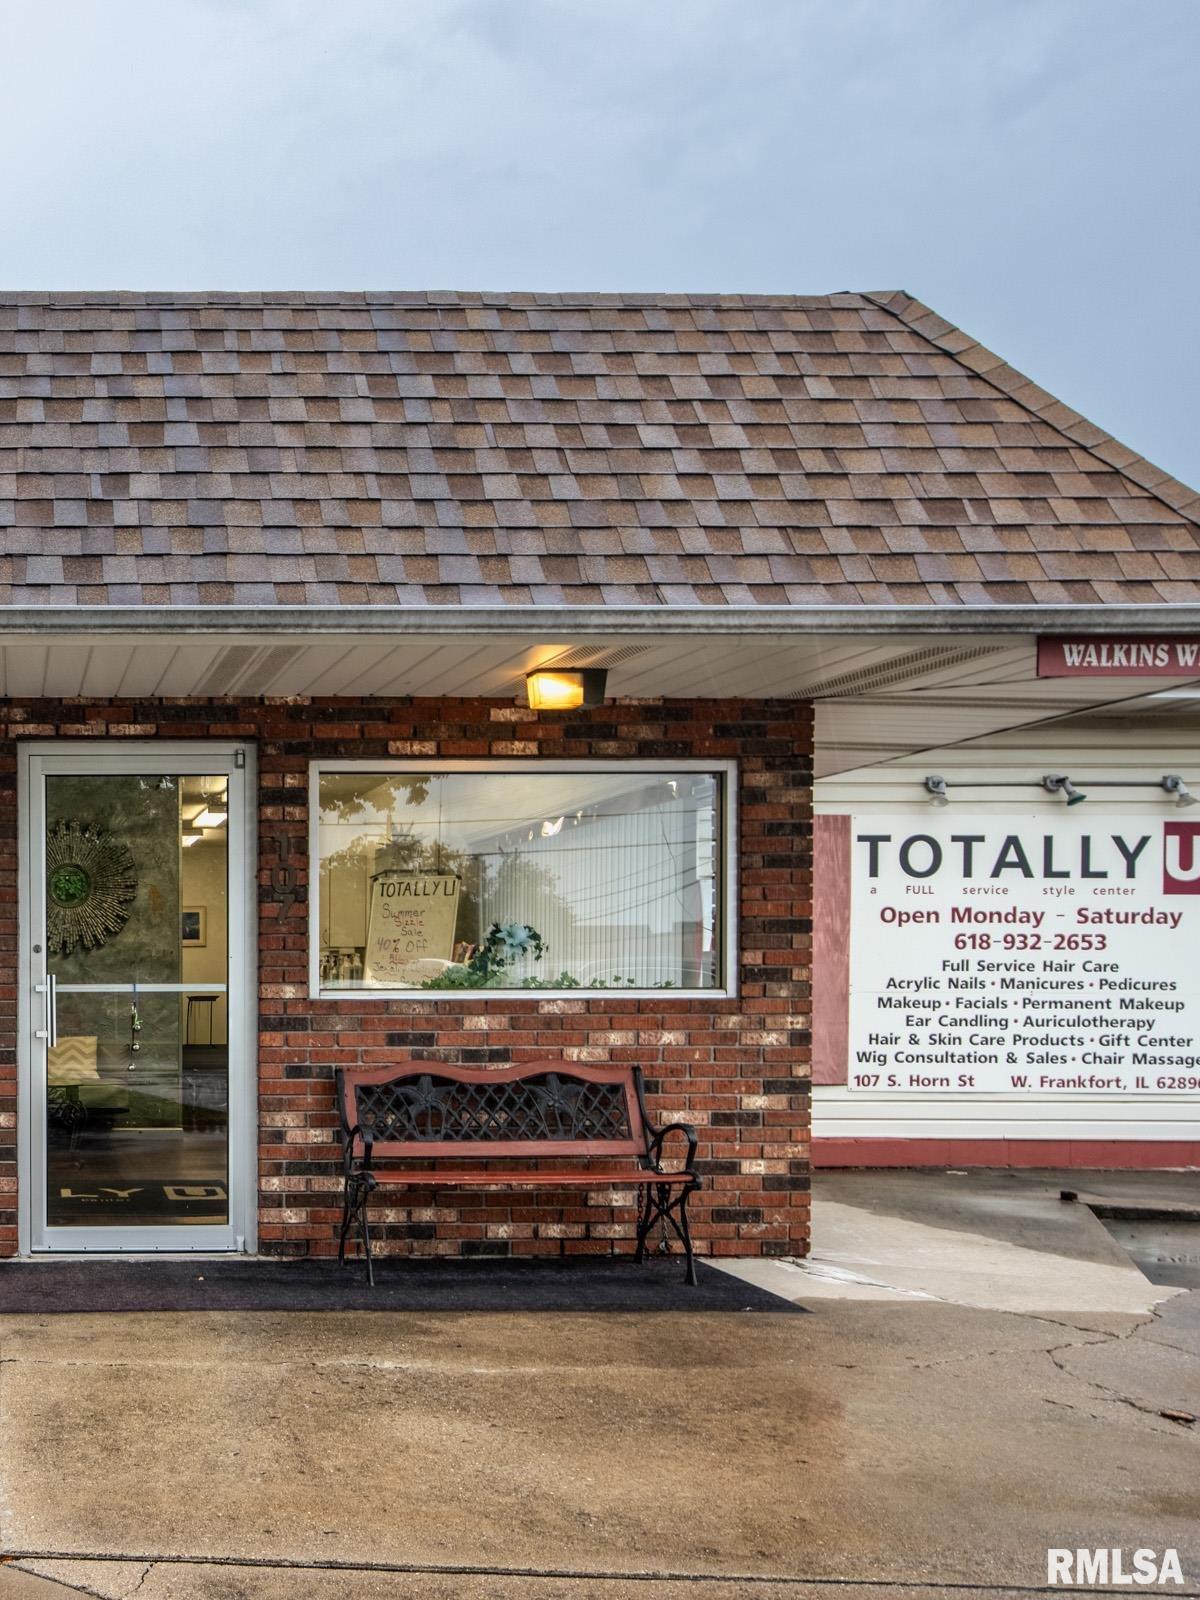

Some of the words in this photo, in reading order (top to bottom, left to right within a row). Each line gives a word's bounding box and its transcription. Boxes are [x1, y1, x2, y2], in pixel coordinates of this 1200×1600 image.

[1062, 644, 1170, 667] WALKINS
[1176, 644, 1200, 667] W
[856, 833, 1153, 880] TOTALLY
[1164, 834, 1200, 881] U
[379, 881, 441, 898] TOTALLY
[443, 879, 457, 896] U
[869, 886, 878, 896] a
[905, 885, 935, 895] FULL
[961, 885, 1010, 896] service
[1042, 885, 1076, 898] style
[1092, 886, 1137, 896] center
[382, 903, 426, 919] Summer
[879, 906, 940, 928] Open
[951, 905, 1046, 929] Monday
[1076, 906, 1184, 930] Saturday
[400, 926, 424, 936] Sale
[954, 932, 1107, 951] 618-932-2653
[942, 959, 970, 972] Full
[976, 959, 1036, 973] Service
[1042, 959, 1076, 973] Hair
[1081, 960, 1120, 973] Care
[885, 976, 941, 992] Acrylic
[947, 977, 986, 990] Nails
[1000, 977, 1085, 991] Manicures
[1099, 977, 1177, 991] Pedicures
[877, 996, 942, 1011] Makeup
[955, 996, 1008, 1010] Facials
[1022, 997, 1112, 1010] Permanent
[1119, 998, 1185, 1013] Makeup
[905, 1014, 932, 1027] Ear
[938, 1014, 1009, 1031] Candling
[1022, 1015, 1156, 1032] Auriculotherapy
[868, 1033, 901, 1046] Hair
[908, 1033, 921, 1046] &
[928, 1033, 962, 1046] Skin
[968, 1033, 1006, 1046] Care
[1012, 1033, 1085, 1047] Products
[1098, 1034, 1131, 1047] Gift
[1137, 1034, 1194, 1048] Center
[856, 1050, 888, 1067] Wig
[894, 1051, 999, 1065] Consultation
[1005, 1052, 1019, 1065] &
[1026, 1052, 1068, 1065] Sales
[1081, 1052, 1125, 1065] Chair
[853, 1074, 880, 1088] 107
[887, 1074, 901, 1088] S.
[909, 1074, 950, 1088] Horn
[957, 1074, 975, 1088] St
[1010, 1075, 1032, 1088] W.
[1039, 1075, 1127, 1091] Frankfort,
[1135, 1076, 1150, 1089] IL
